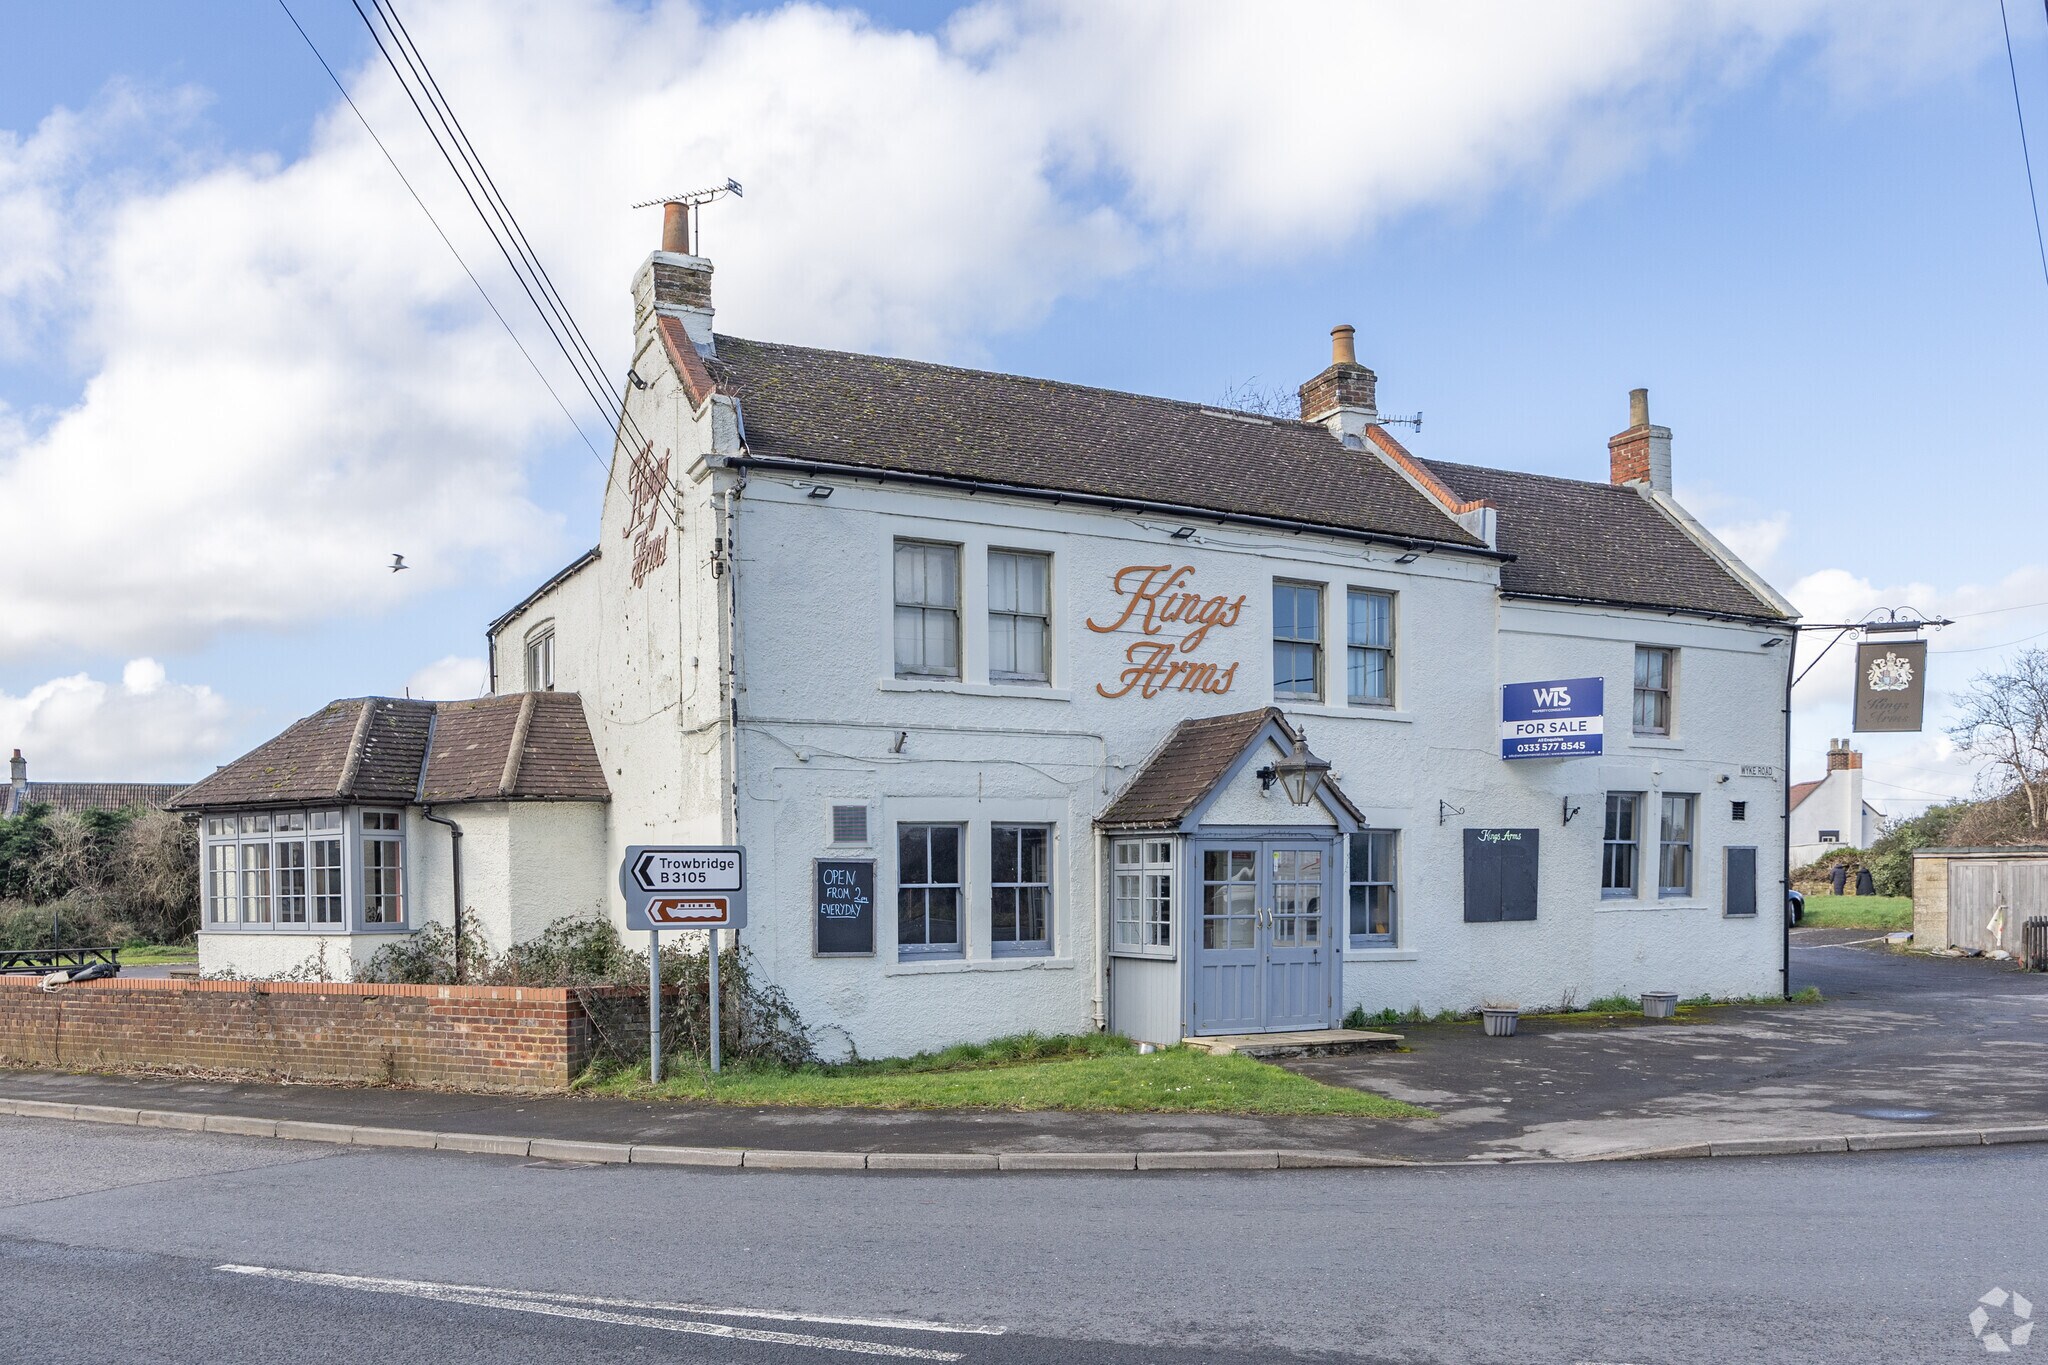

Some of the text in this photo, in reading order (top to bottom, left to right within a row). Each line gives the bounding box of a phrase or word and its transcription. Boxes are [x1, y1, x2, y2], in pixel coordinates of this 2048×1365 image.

[1086, 564, 1247, 653] Kings
[1096, 641, 1240, 699] Arms
[1516, 720, 1587, 736] FOR SALE
[1517, 741, 1586, 753] 0333 577 8545
[1741, 766, 1773, 776] WYKE ROAD
[1477, 829, 1522, 844] Kings Arms
[659, 857, 734, 871] Trowbridge
[823, 869, 856, 885] OPEN
[826, 887, 850, 899] FROM
[820, 903, 861, 918] EVERYDAY
